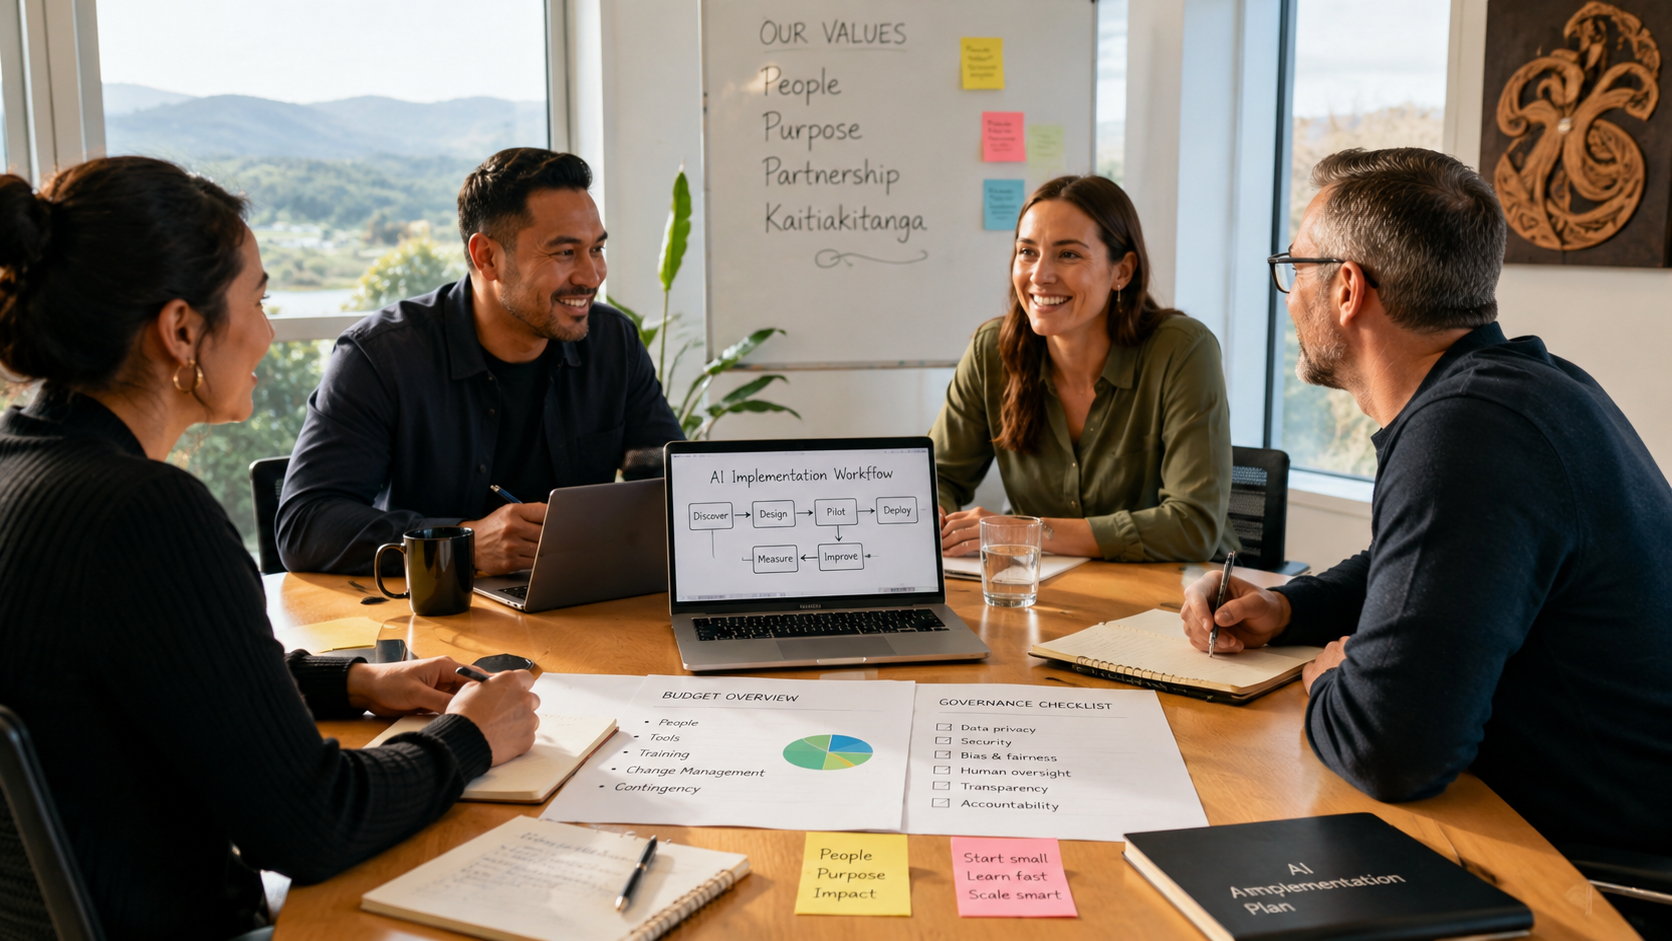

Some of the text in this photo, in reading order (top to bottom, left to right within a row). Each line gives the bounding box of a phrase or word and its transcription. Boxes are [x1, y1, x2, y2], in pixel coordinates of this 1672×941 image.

[760, 19, 907, 45] OUR VALUES
[761, 65, 842, 106] People
[762, 111, 863, 151] Purpose
[762, 156, 900, 195] Partnership
[765, 202, 928, 243] Kaitiakitanga
[710, 470, 725, 484] AI
[732, 468, 828, 488] Implementation
[693, 511, 729, 521] Discover
[760, 510, 788, 522] Design
[826, 507, 846, 517] Pilot
[883, 506, 912, 517] Deploy
[758, 554, 793, 564] Measure
[824, 551, 859, 562] Improve
[662, 691, 800, 702] BUDGET OVERVIEW
[939, 698, 1113, 710] GOVERNANCE CHECKLIST
[658, 718, 699, 728] People
[961, 723, 1036, 735] Data privacy
[650, 734, 680, 742] Tools
[961, 737, 1012, 748] Security
[639, 748, 690, 760] Training
[961, 752, 1058, 762] Bias & fairness
[626, 765, 766, 779] Change Management
[961, 766, 1072, 779] Human oversight
[615, 782, 701, 795] Contingency
[961, 782, 1048, 794] Transparency
[961, 799, 1060, 812] Accountability
[820, 848, 873, 864] People
[964, 852, 1049, 864] Start small
[817, 867, 886, 883] Purpose
[1287, 862, 1314, 876] AI
[967, 870, 1048, 881] Learn fast
[813, 887, 877, 901] Impact
[969, 889, 1062, 900] Scale smart
[1243, 901, 1295, 916] Plan
